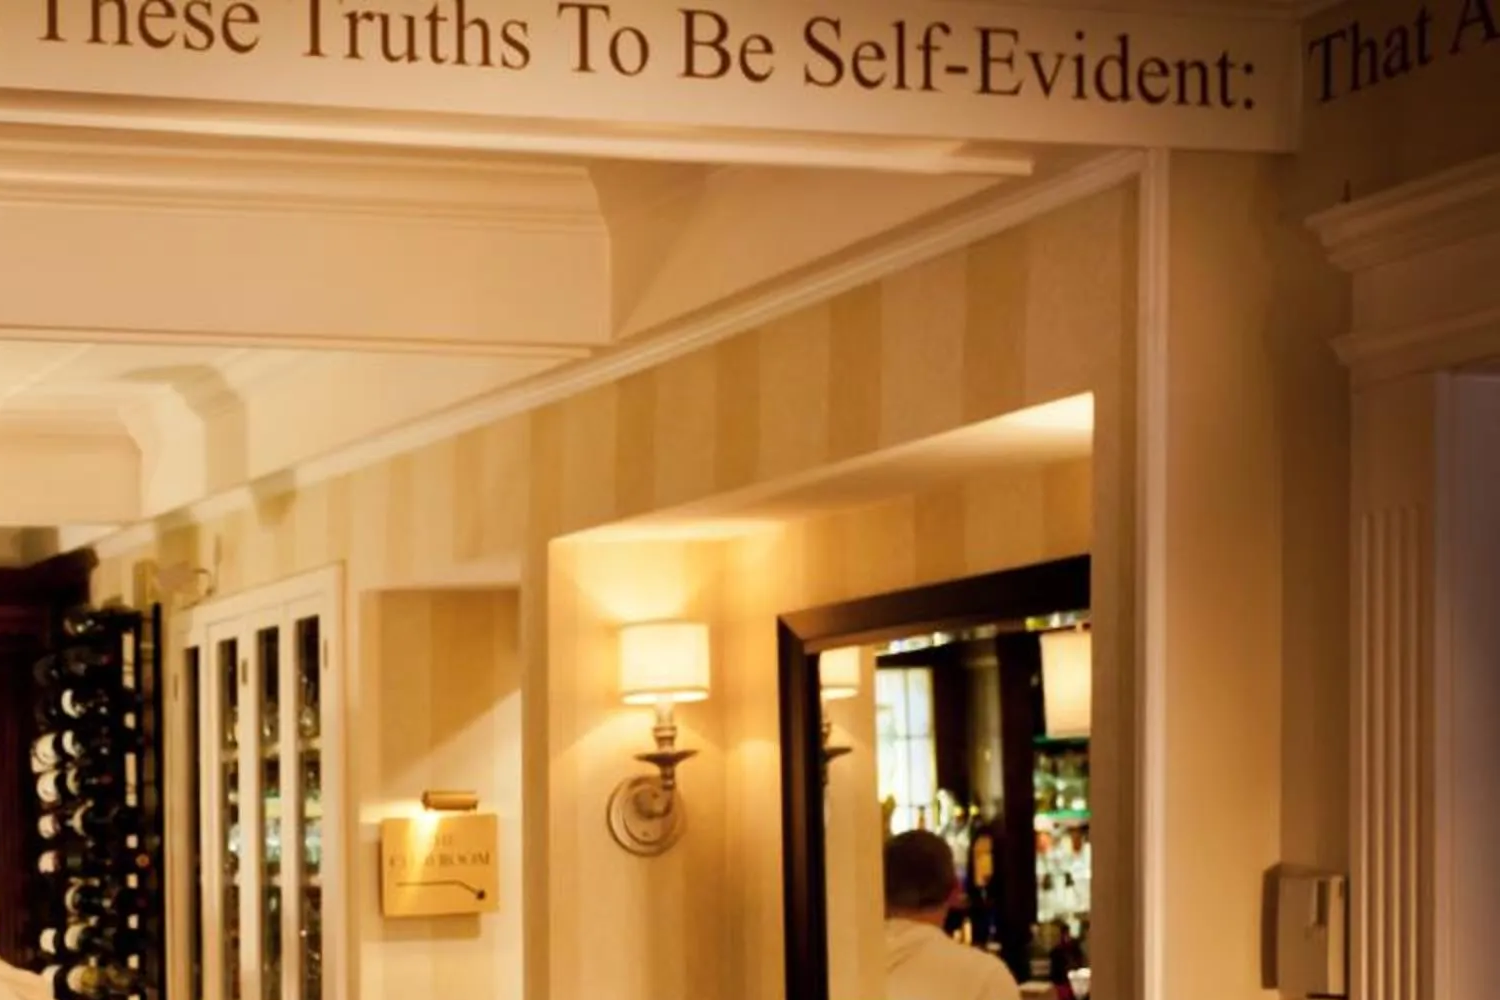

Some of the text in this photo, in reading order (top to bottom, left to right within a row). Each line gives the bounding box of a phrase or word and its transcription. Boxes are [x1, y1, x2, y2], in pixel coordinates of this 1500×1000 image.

[38, 0, 261, 53] These
[301, 0, 531, 70] Truths
[557, 2, 650, 77] To
[677, 9, 777, 83] Be
[803, 16, 1255, 110] Self-Evident:
[1308, 4, 1434, 103] That
